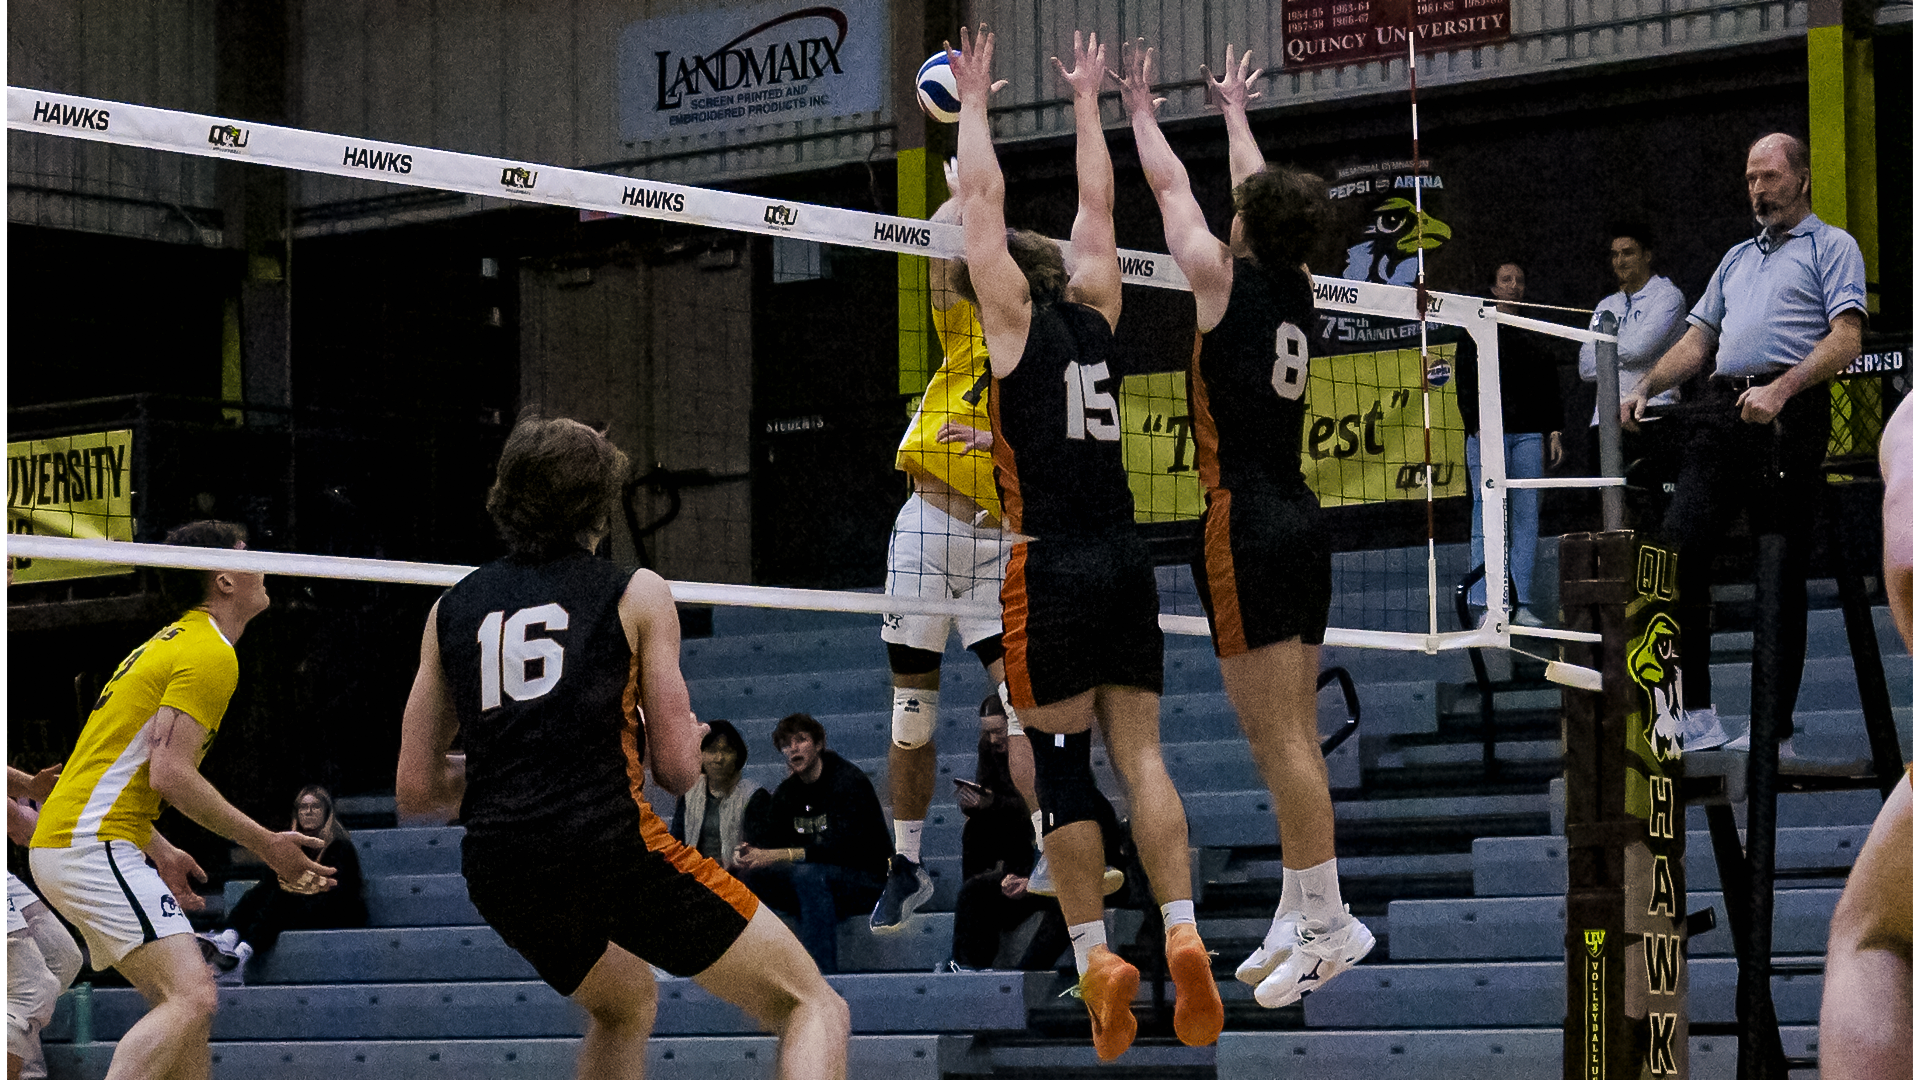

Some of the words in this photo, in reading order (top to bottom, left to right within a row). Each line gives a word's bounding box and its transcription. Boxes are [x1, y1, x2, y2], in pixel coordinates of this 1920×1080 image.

[1286, 33, 1367, 61] QUINCY
[1375, 13, 1504, 45] UNVERSITY
[655, 36, 844, 111] LANDMARX
[690, 94, 734, 110] SCREEN
[737, 88, 783, 104] PRINTED
[786, 84, 808, 97] AND
[33, 100, 110, 131] HAWKS
[669, 106, 746, 126] EMBROIDERED
[748, 97, 806, 115] PRODUCTS
[342, 146, 413, 174] HAWKS
[1381, 160, 1429, 171] GYMNASUM
[621, 186, 685, 213] HAWKS
[1329, 181, 1370, 200] PEPSI
[874, 221, 931, 247] HAWKS
[1116, 256, 1155, 277] WKS
[1313, 283, 1359, 304] HAWKS
[1271, 321, 1309, 400] 8
[1064, 360, 1121, 441] 15
[1636, 544, 1678, 602] QU
[477, 602, 570, 712] 16
